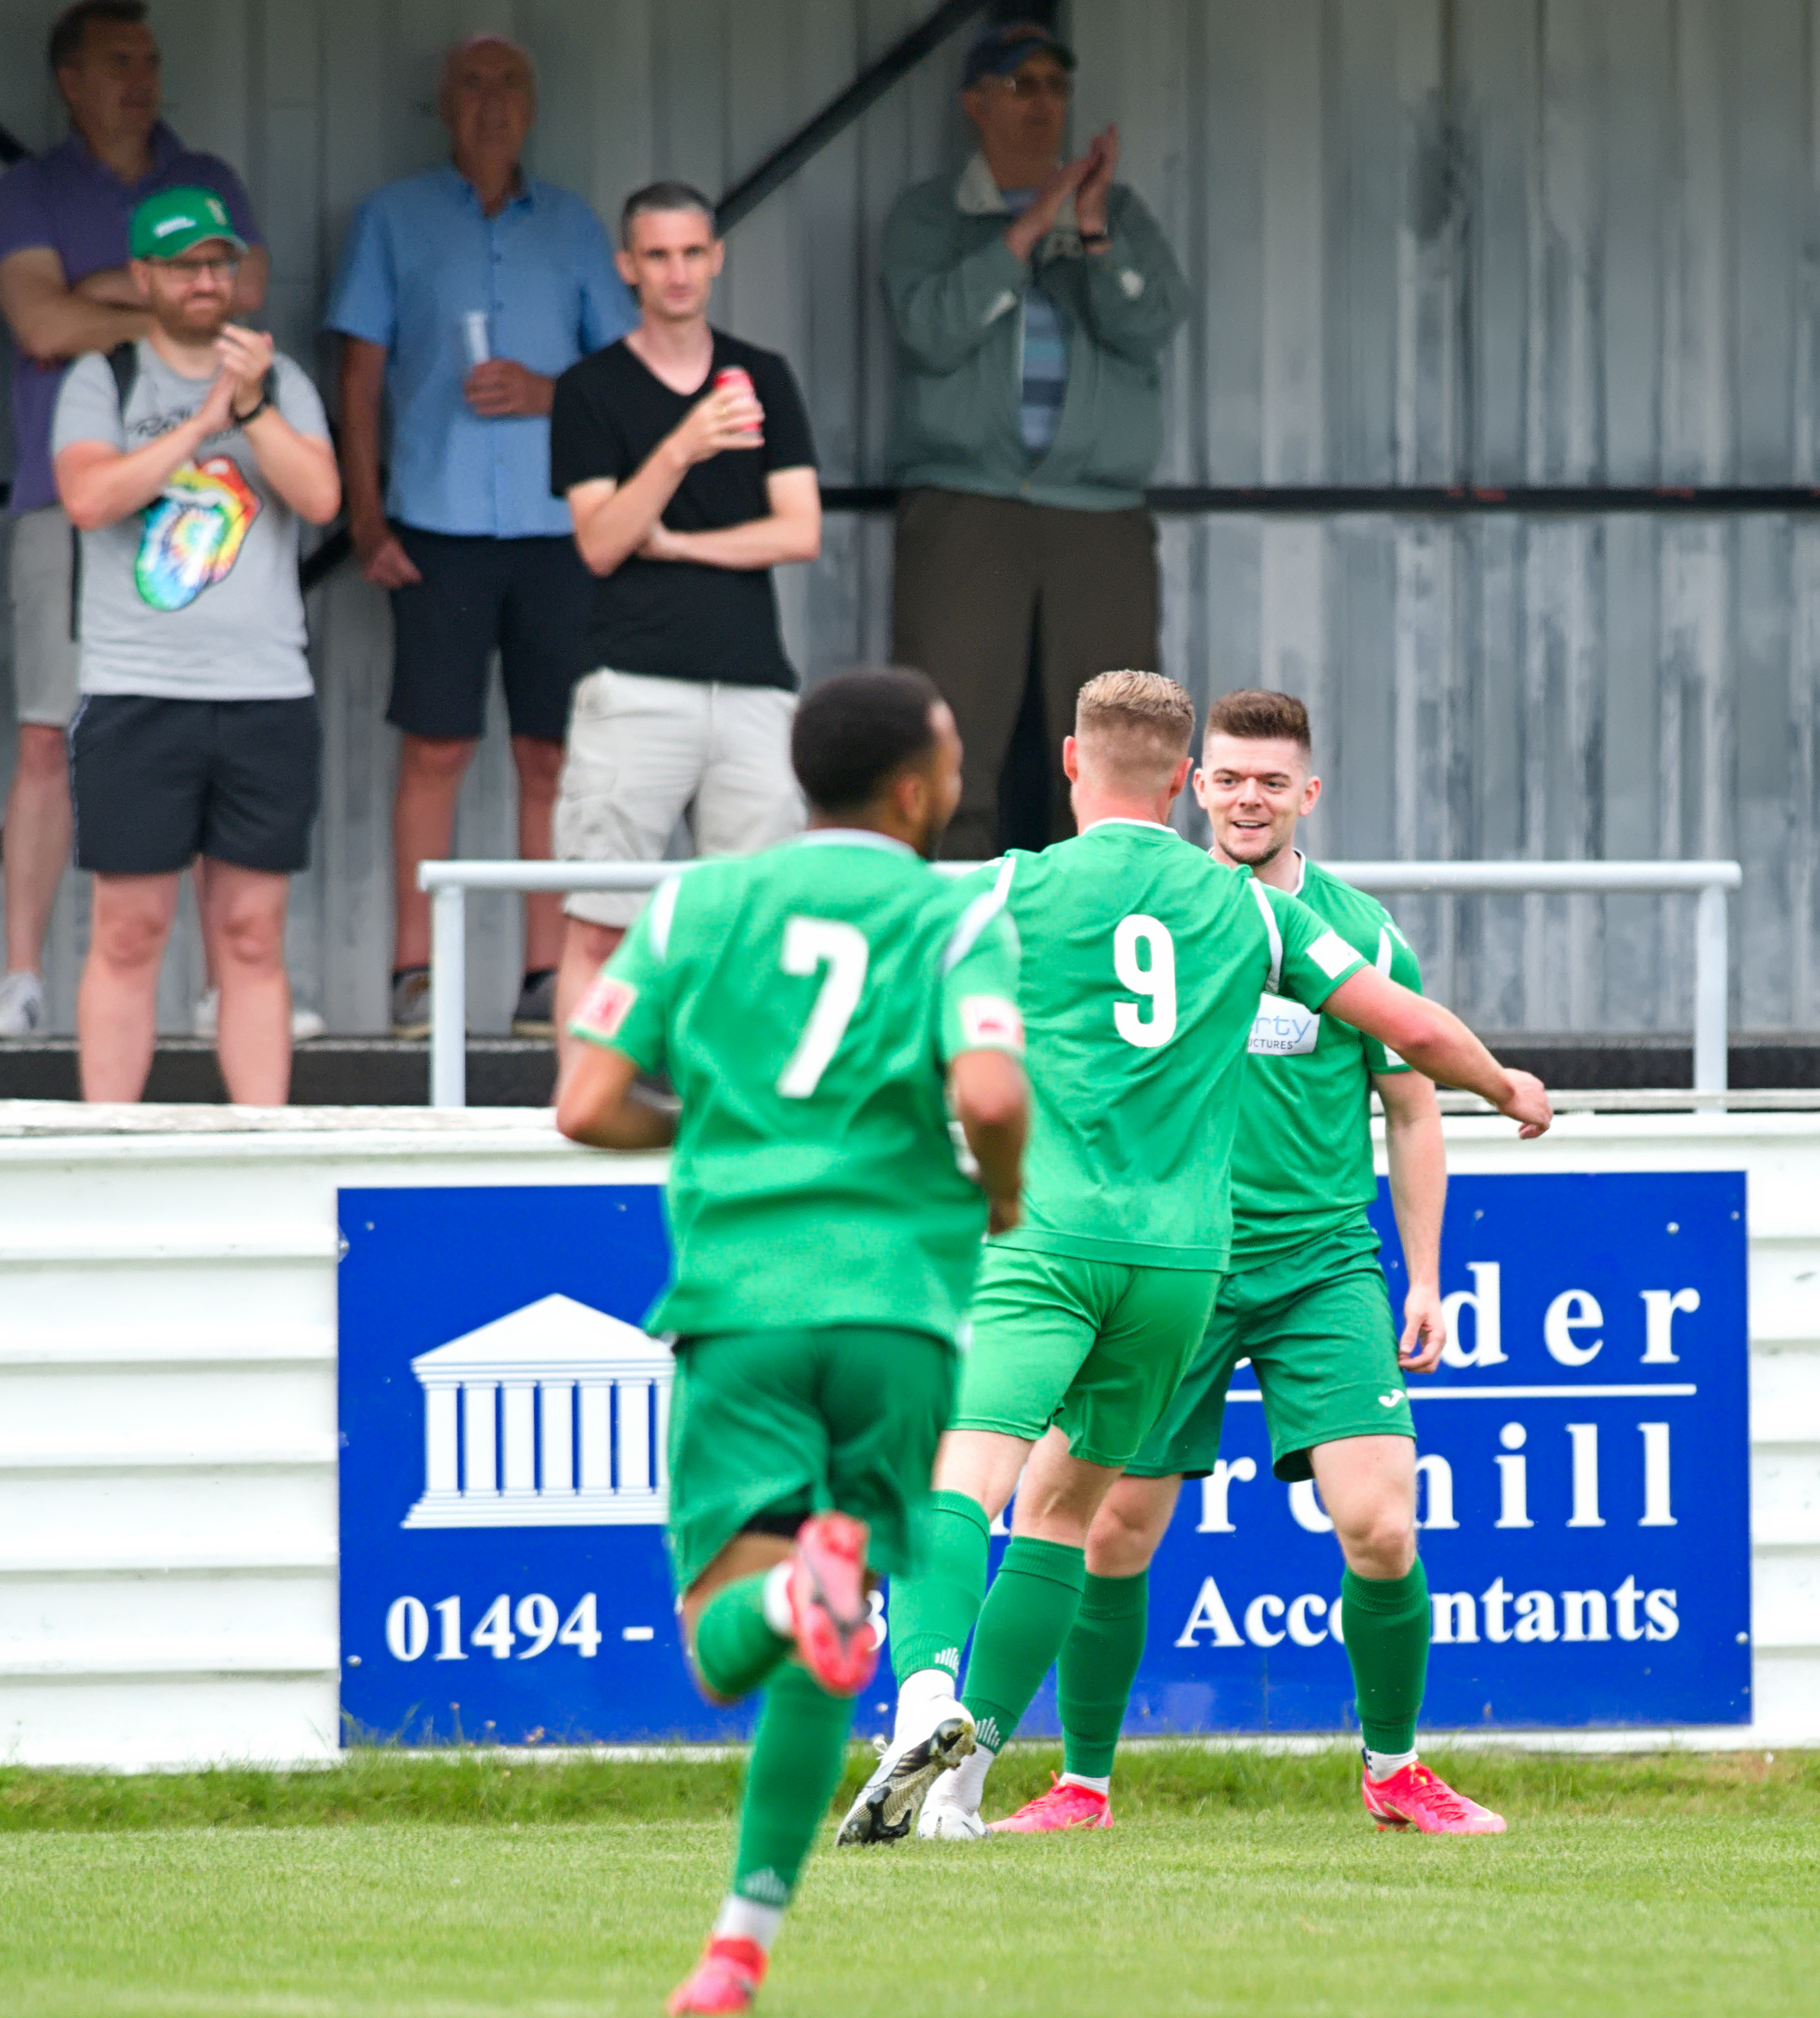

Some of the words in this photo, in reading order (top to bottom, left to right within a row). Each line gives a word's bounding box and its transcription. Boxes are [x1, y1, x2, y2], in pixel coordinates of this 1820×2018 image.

[777, 914, 869, 1098] 7
[1113, 914, 1177, 1048] 9
[1252, 1015, 1312, 1043] rty
[1439, 1261, 1701, 1368] der
[385, 1592, 602, 1662] 01494
[1174, 1574, 1681, 1648] Accntants
